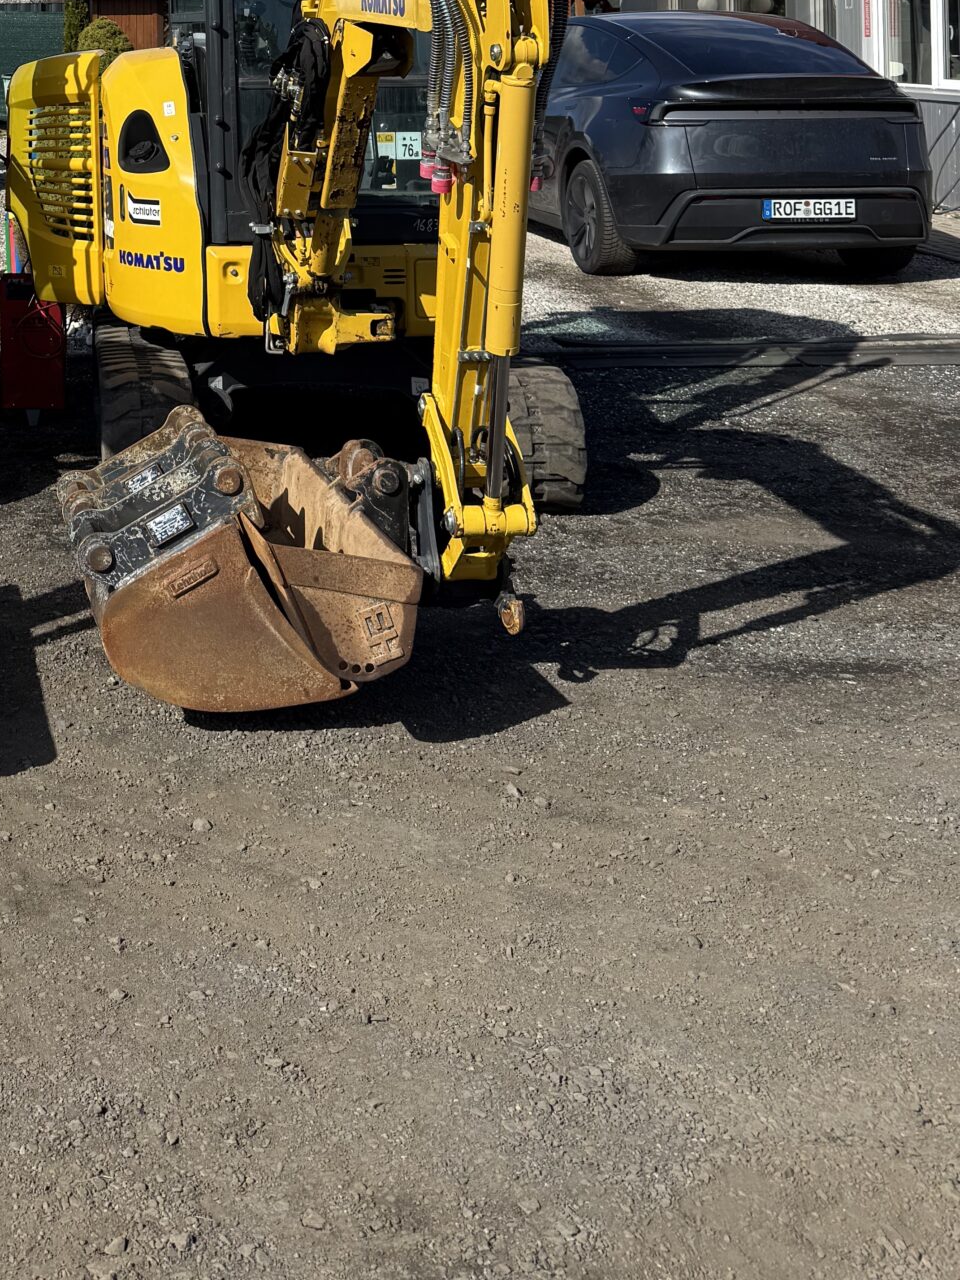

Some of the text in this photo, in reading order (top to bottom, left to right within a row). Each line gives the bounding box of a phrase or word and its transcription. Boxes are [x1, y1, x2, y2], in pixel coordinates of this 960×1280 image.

[773, 201, 854, 216] ROF GG1E
[119, 250, 185, 273] KOMATSU
